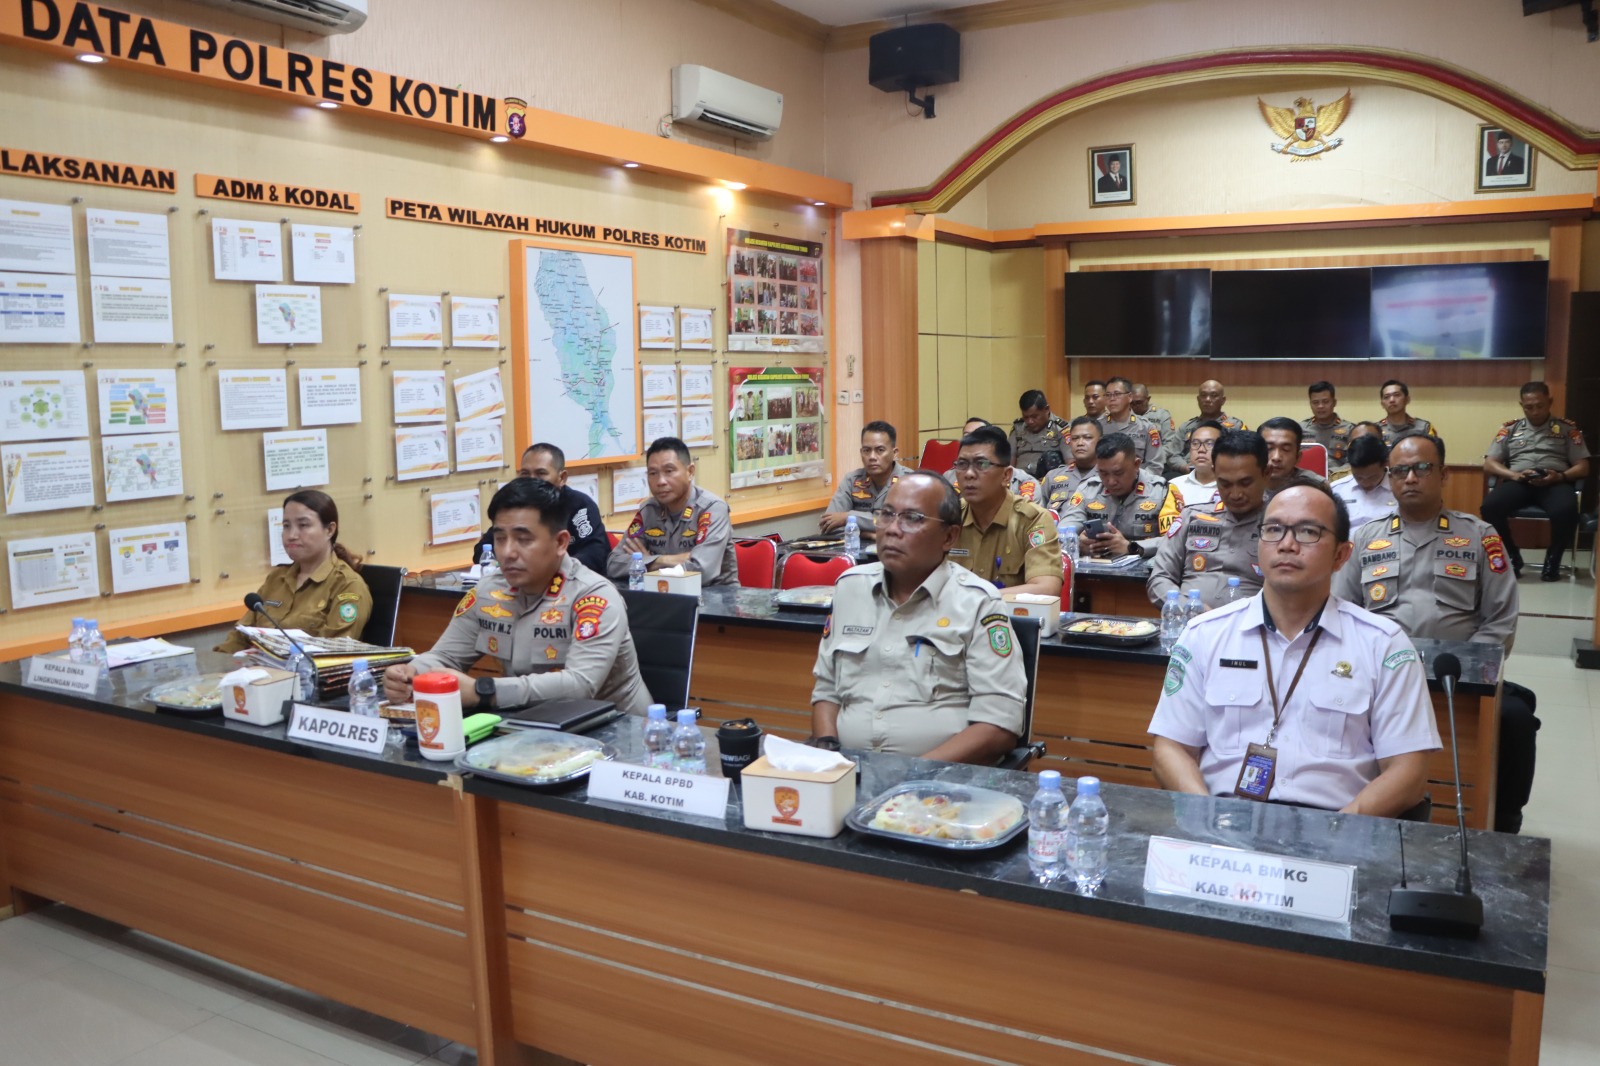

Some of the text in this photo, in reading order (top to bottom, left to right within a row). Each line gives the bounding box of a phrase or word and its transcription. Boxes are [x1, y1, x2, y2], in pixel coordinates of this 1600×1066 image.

[21, 0, 496, 132] DATA POLRES KOTIM
[213, 179, 354, 210] ADM & KODAL
[390, 200, 706, 252] PETA WILAYAH HUKUM POLRES KOTIM
[1362, 552, 1397, 565] BAMBANG
[1436, 550, 1475, 561] POLRI
[534, 627, 567, 639] POLRI
[44, 663, 84, 676] KEPALA DINAS
[33, 675, 89, 689] LINGKUNGAN HIDUP
[298, 715, 379, 744] KAPOLRES
[622, 770, 693, 789] KEPALA BPBD
[624, 790, 684, 807] KAB. KOTIM
[1189, 854, 1308, 883] KEPALA BMKG
[1195, 881, 1293, 908] KAB. KOTIM
